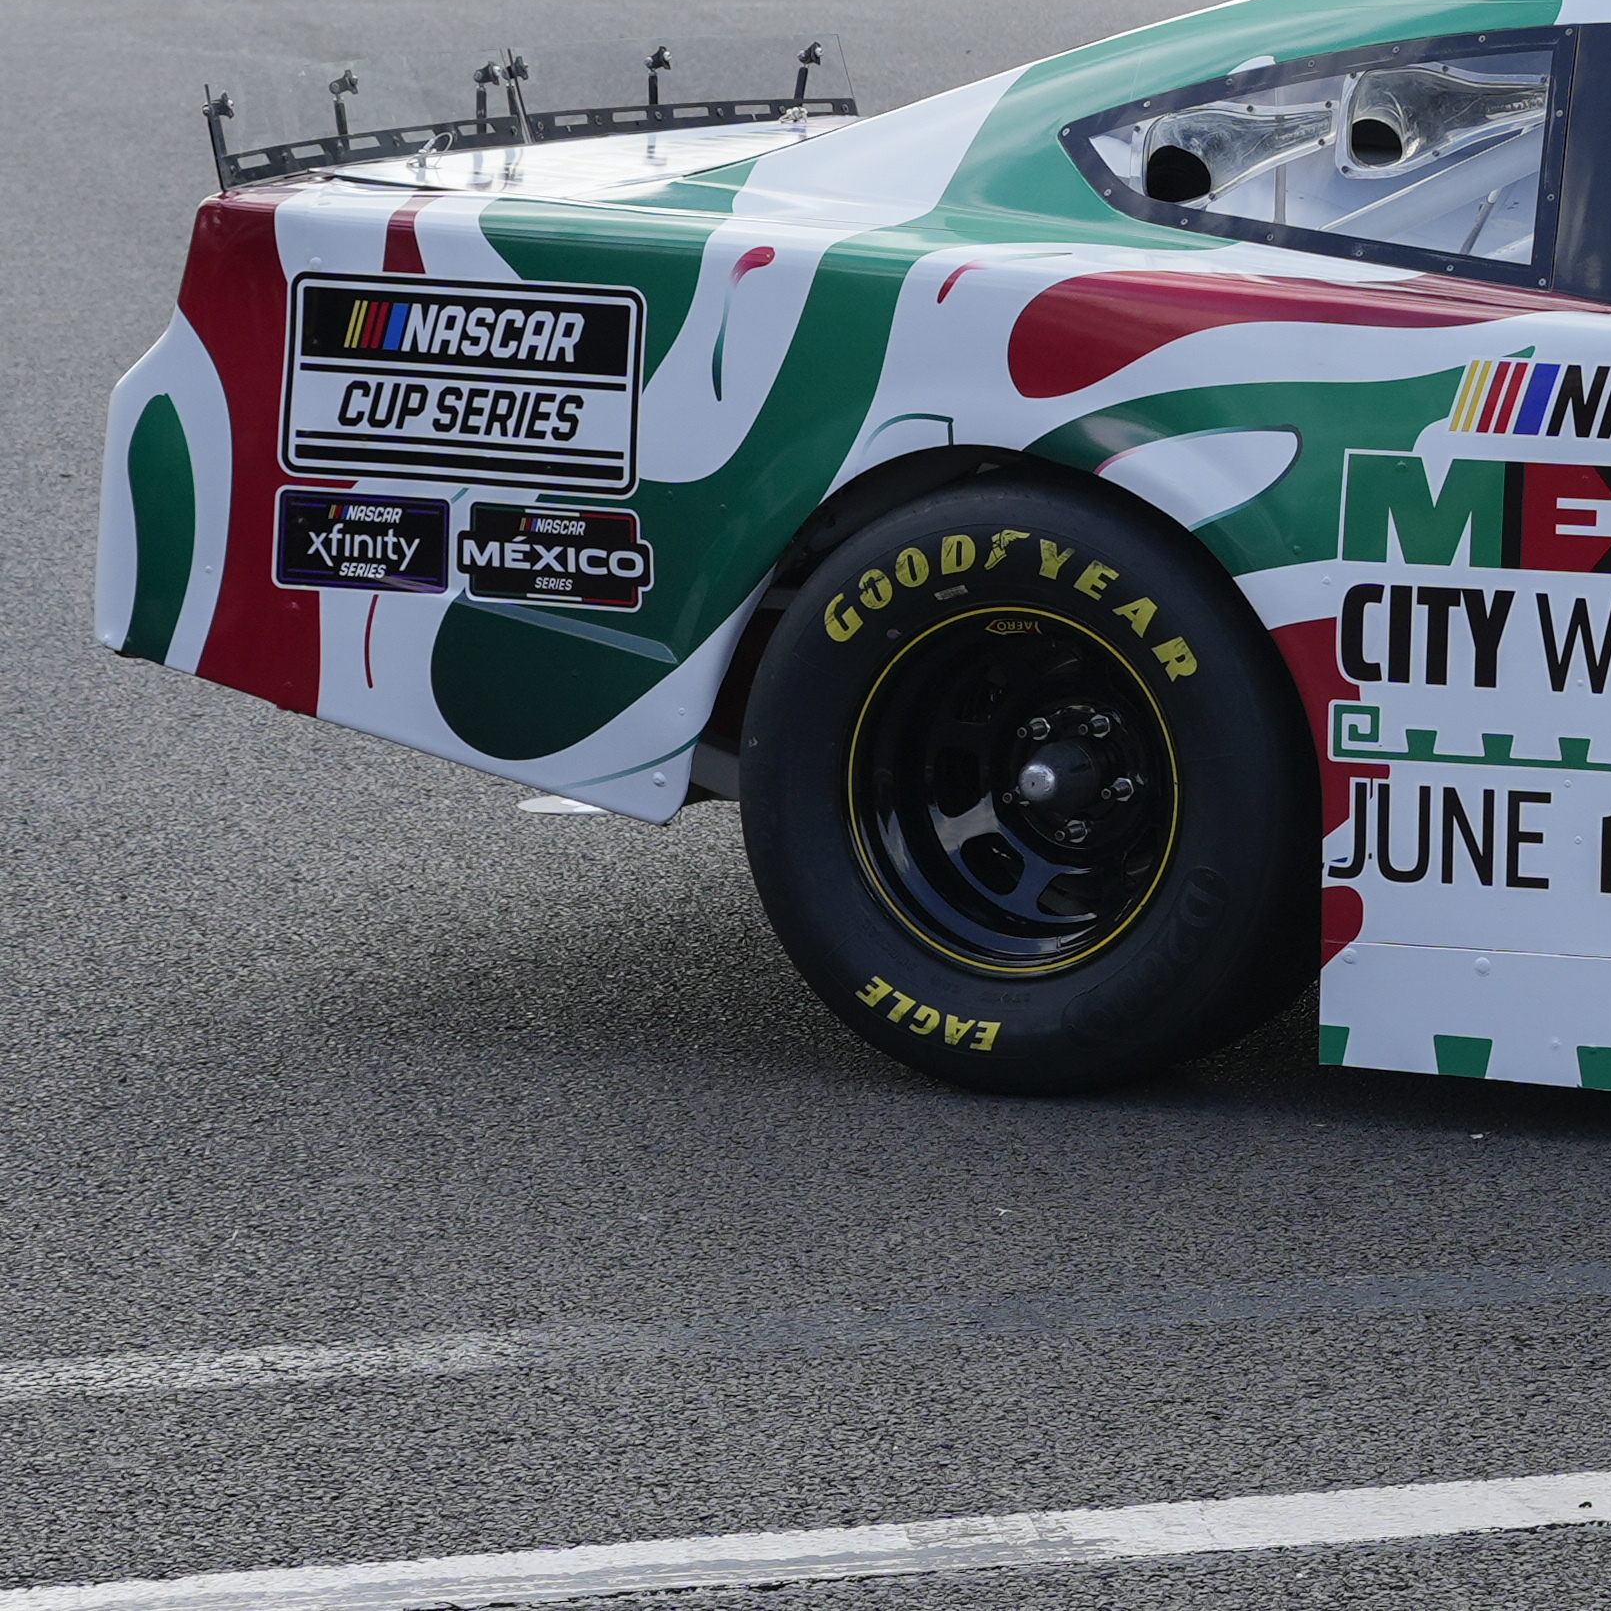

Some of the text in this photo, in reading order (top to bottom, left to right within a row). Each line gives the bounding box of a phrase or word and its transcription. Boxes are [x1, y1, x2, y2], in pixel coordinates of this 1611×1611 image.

[401, 303, 585, 363] NASCAR
[338, 380, 584, 441] CUP SERIES
[346, 504, 403, 524] NASCAR
[535, 518, 586, 536] NASCAR
[306, 523, 421, 572] xfinity
[339, 562, 387, 579] SERIES
[463, 535, 645, 578] MÉXICO
[534, 576, 573, 590] SERIES
[823, 530, 1198, 682] GOODYEAR
[1340, 583, 1515, 689] CITY
[1327, 777, 1552, 890] JUNE
[855, 975, 1001, 1052] EAGLE
